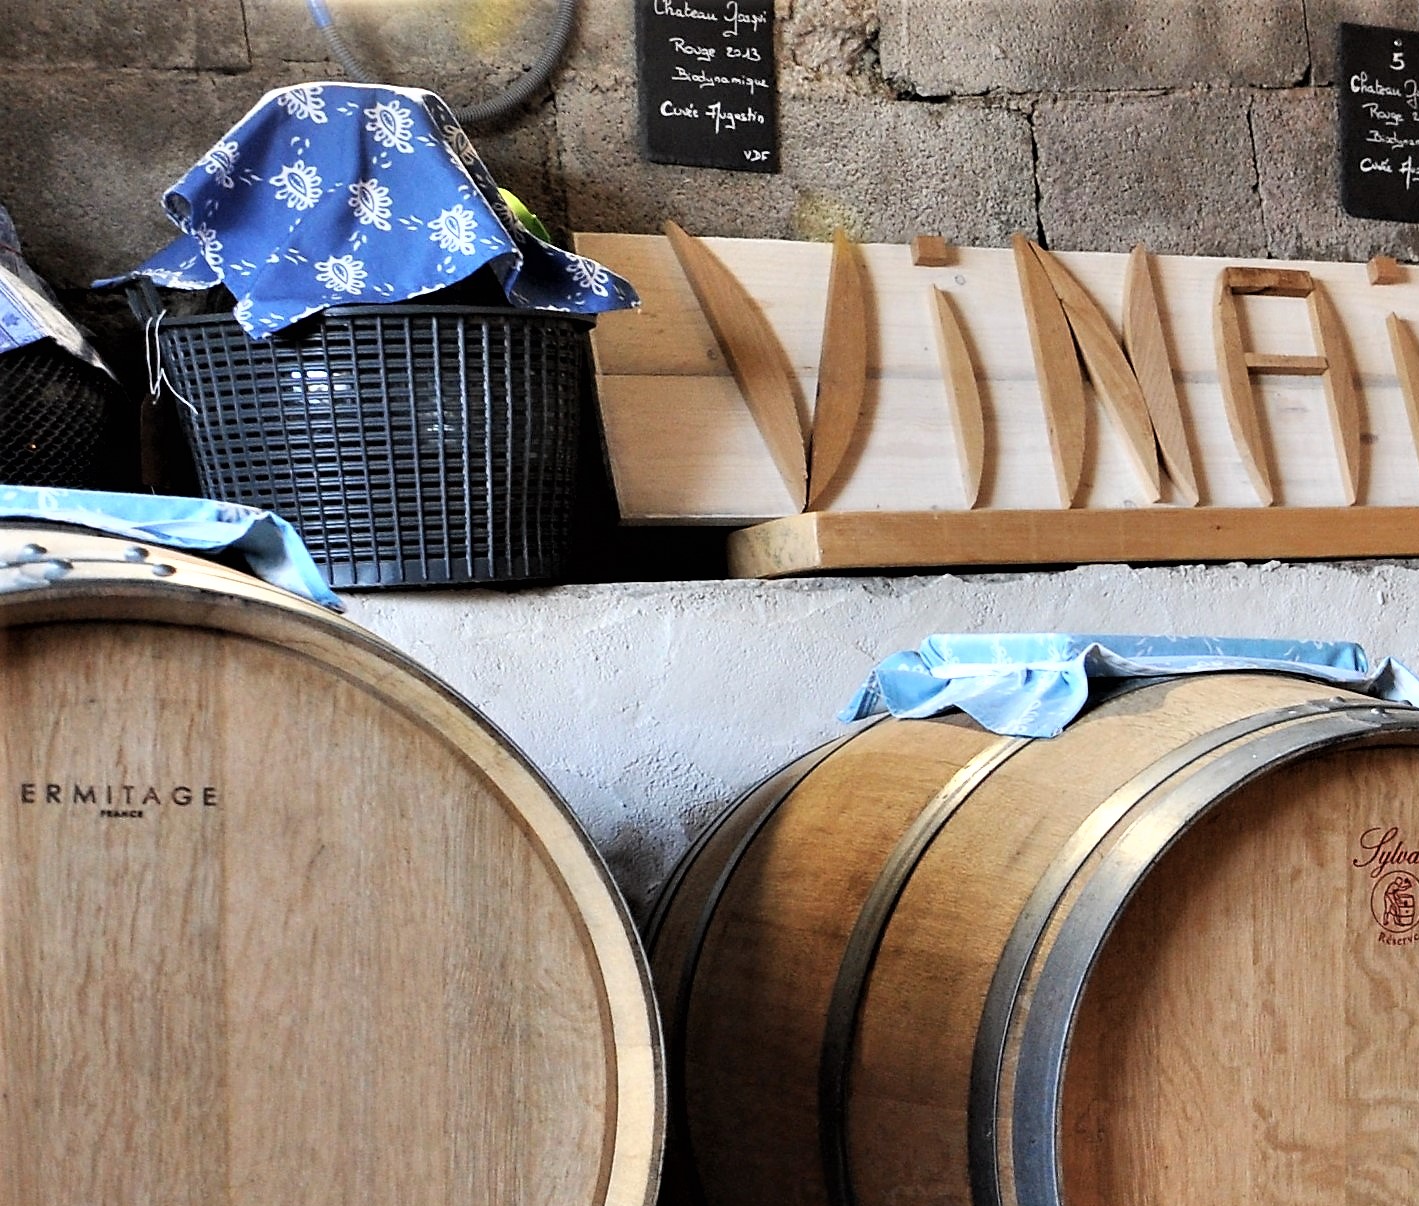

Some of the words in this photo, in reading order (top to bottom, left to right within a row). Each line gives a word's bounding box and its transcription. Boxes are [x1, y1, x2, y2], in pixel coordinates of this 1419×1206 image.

[669, 38, 716, 61] Rouge
[726, 46, 761, 60] 2013
[1390, 52, 1405, 70] 5
[672, 66, 769, 94] Biodynamique
[660, 100, 699, 118] Cuvée
[705, 101, 765, 134] Augustin
[1362, 103, 1404, 125] Rouge
[21, 784, 217, 806] ERMITAGE
[1378, 931, 1419, 946] Réserve
